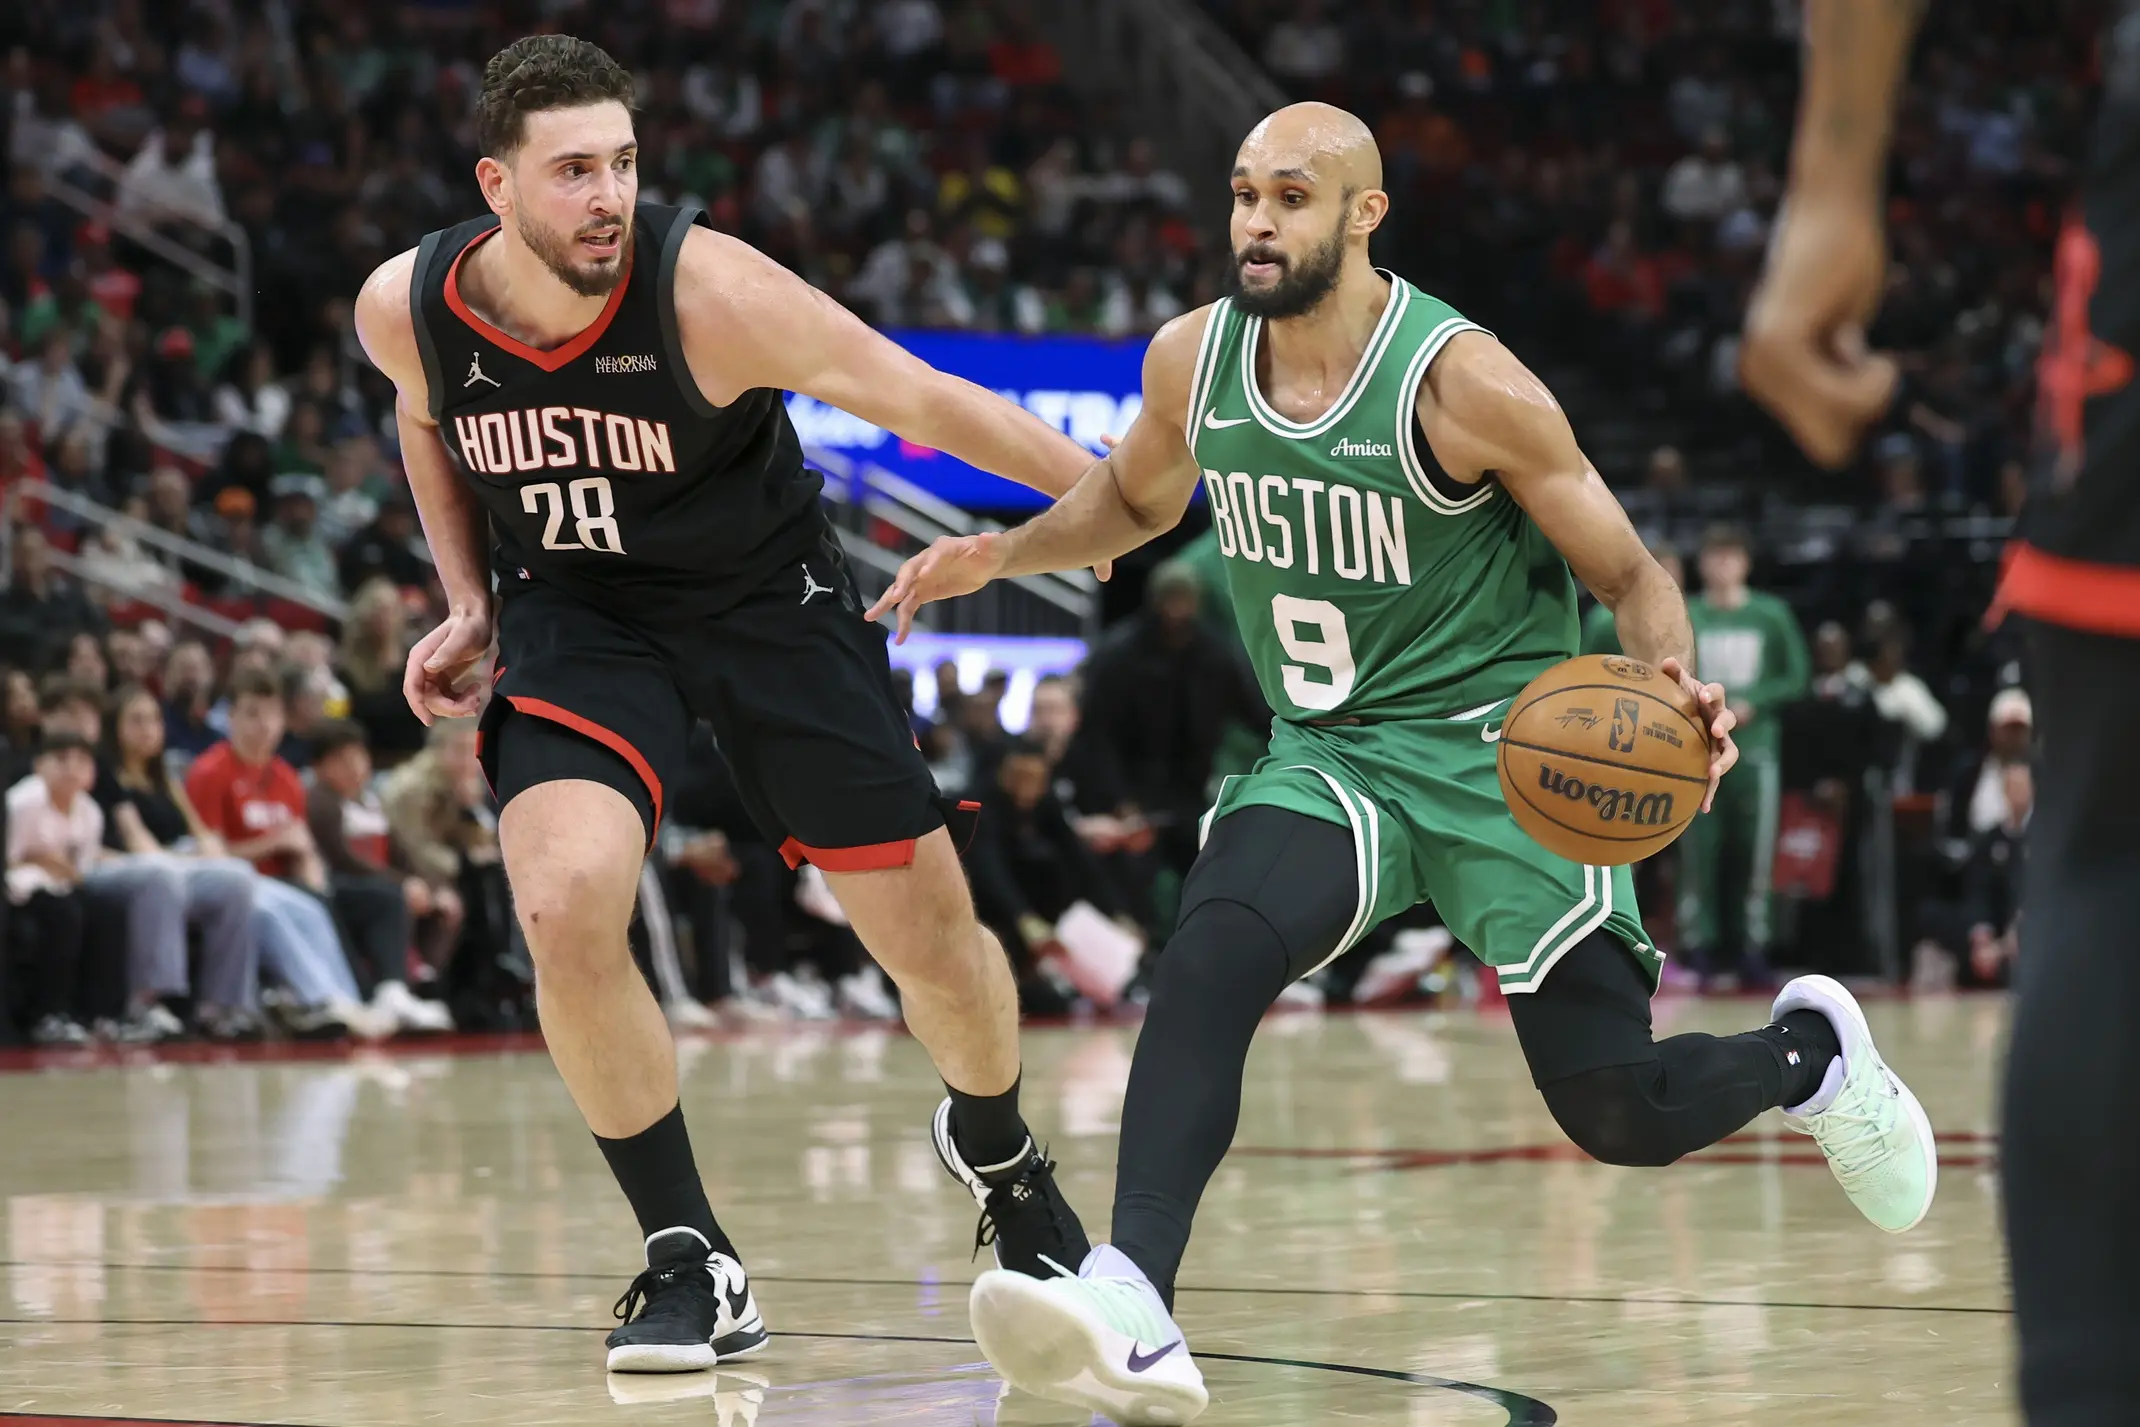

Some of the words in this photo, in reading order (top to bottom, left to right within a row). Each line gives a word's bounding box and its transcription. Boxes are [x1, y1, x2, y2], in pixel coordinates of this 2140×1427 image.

[595, 354, 656, 366] MEMORIAL
[595, 361, 657, 373] HERMANN
[454, 406, 676, 474] HOUSTON
[1330, 437, 1392, 456] Amica
[520, 476, 627, 555] 28
[1203, 468, 1411, 585] BOSTON
[1271, 593, 1356, 711] 9
[1538, 763, 1674, 825] Wilson
